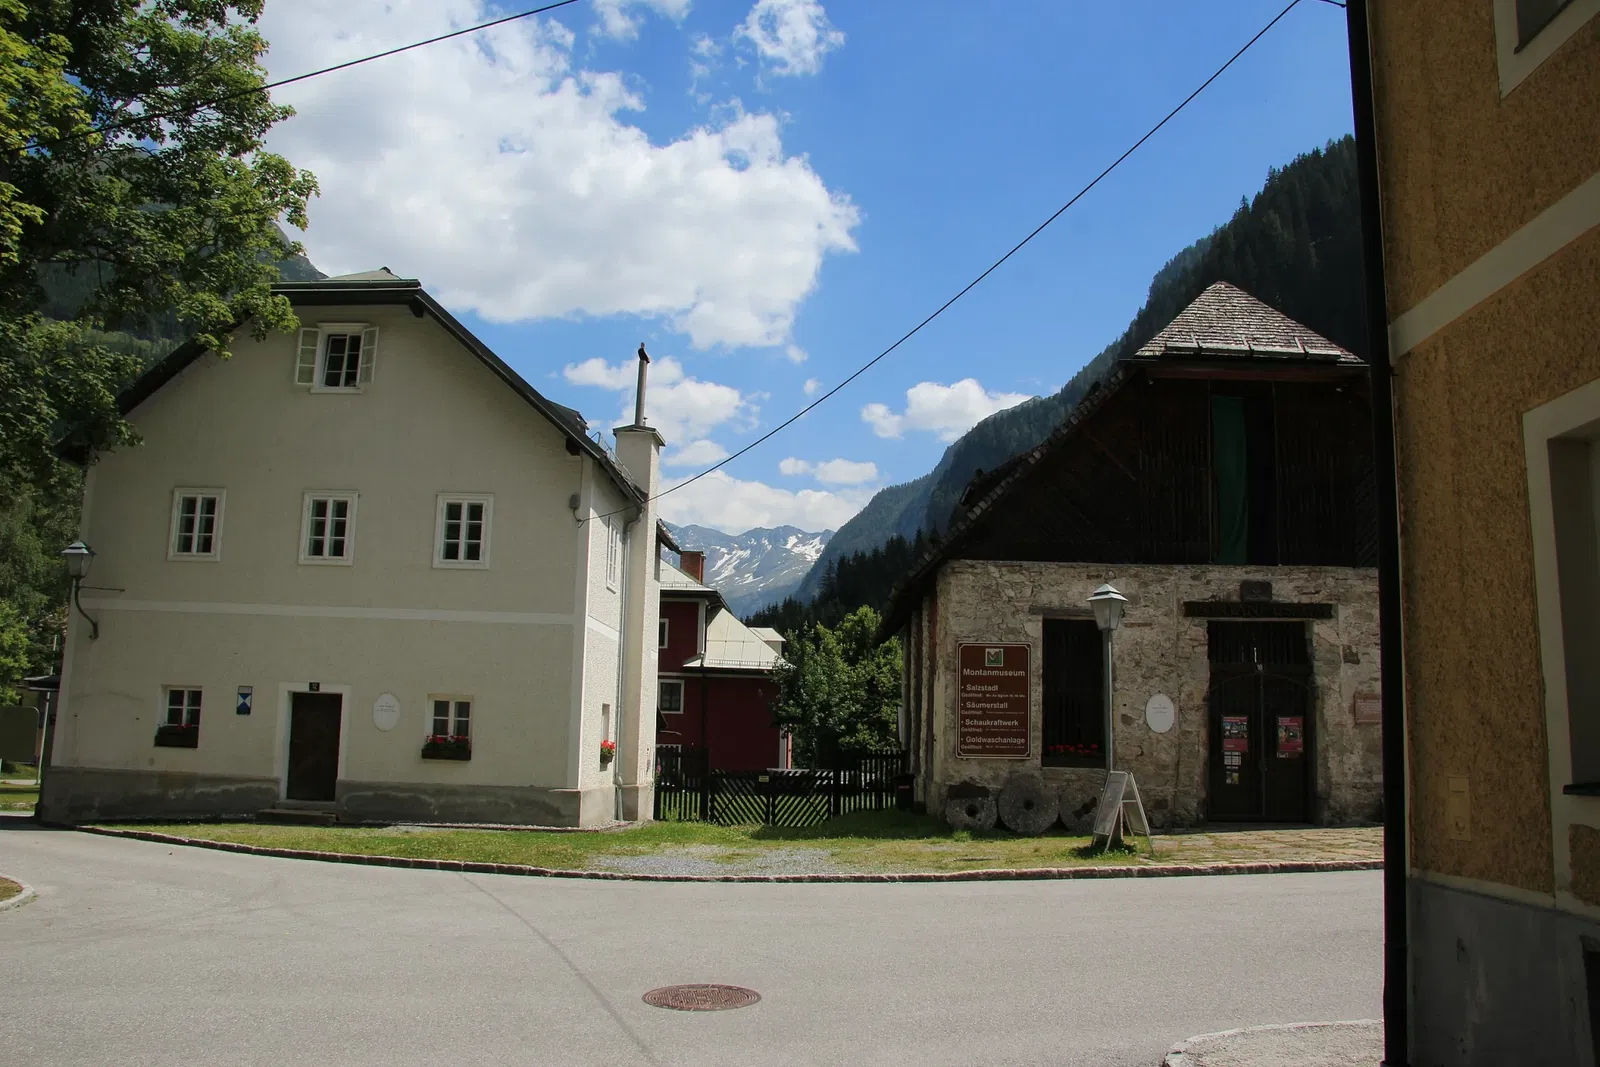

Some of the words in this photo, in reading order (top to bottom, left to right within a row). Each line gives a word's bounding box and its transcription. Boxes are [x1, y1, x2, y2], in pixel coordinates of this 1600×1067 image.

[963, 668, 1025, 677] Montanmuseum
[966, 701, 1008, 709] Säumerstall
[965, 718, 1019, 726] Schaukraftwerk
[965, 736, 1025, 744] Goldwaschanlage
